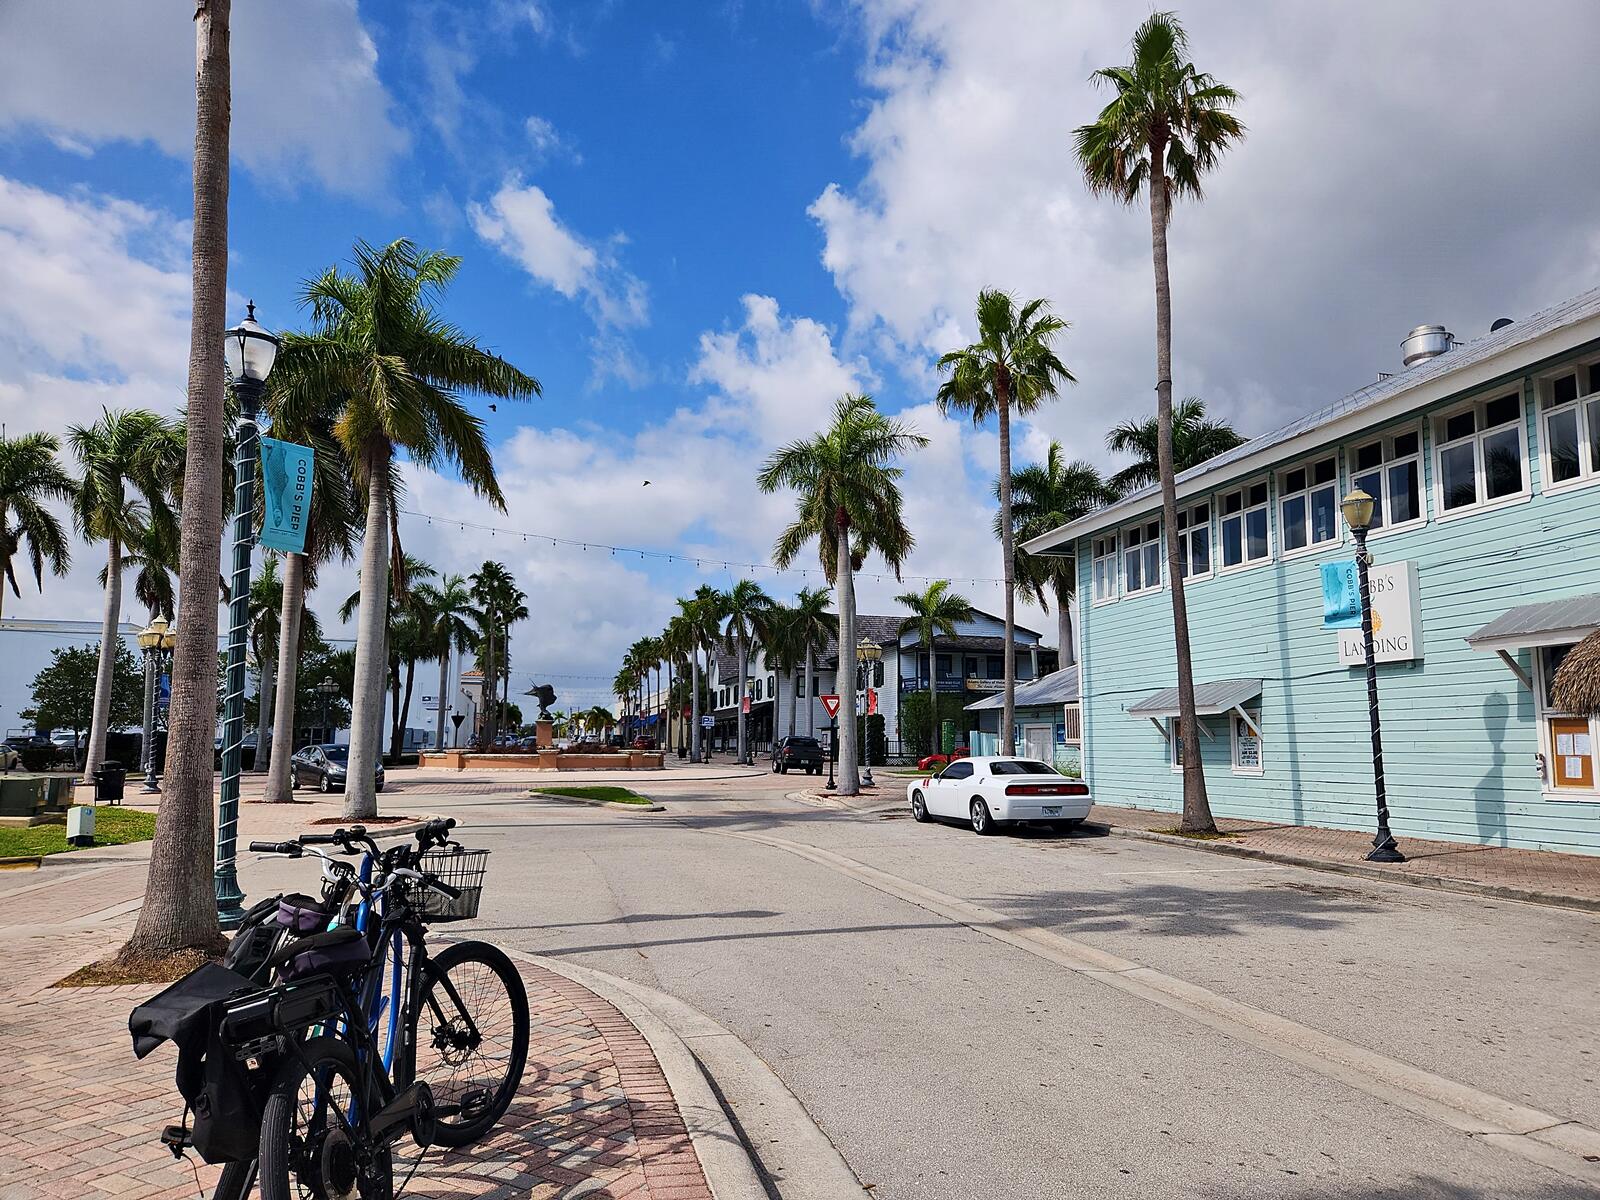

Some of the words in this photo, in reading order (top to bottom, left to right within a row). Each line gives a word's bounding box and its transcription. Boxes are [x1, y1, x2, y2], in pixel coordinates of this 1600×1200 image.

[295, 459, 306, 501] COBB'S
[291, 505, 301, 530] PIER
[1346, 569, 1354, 596] COBB'S
[1369, 574, 1394, 594] BB'S
